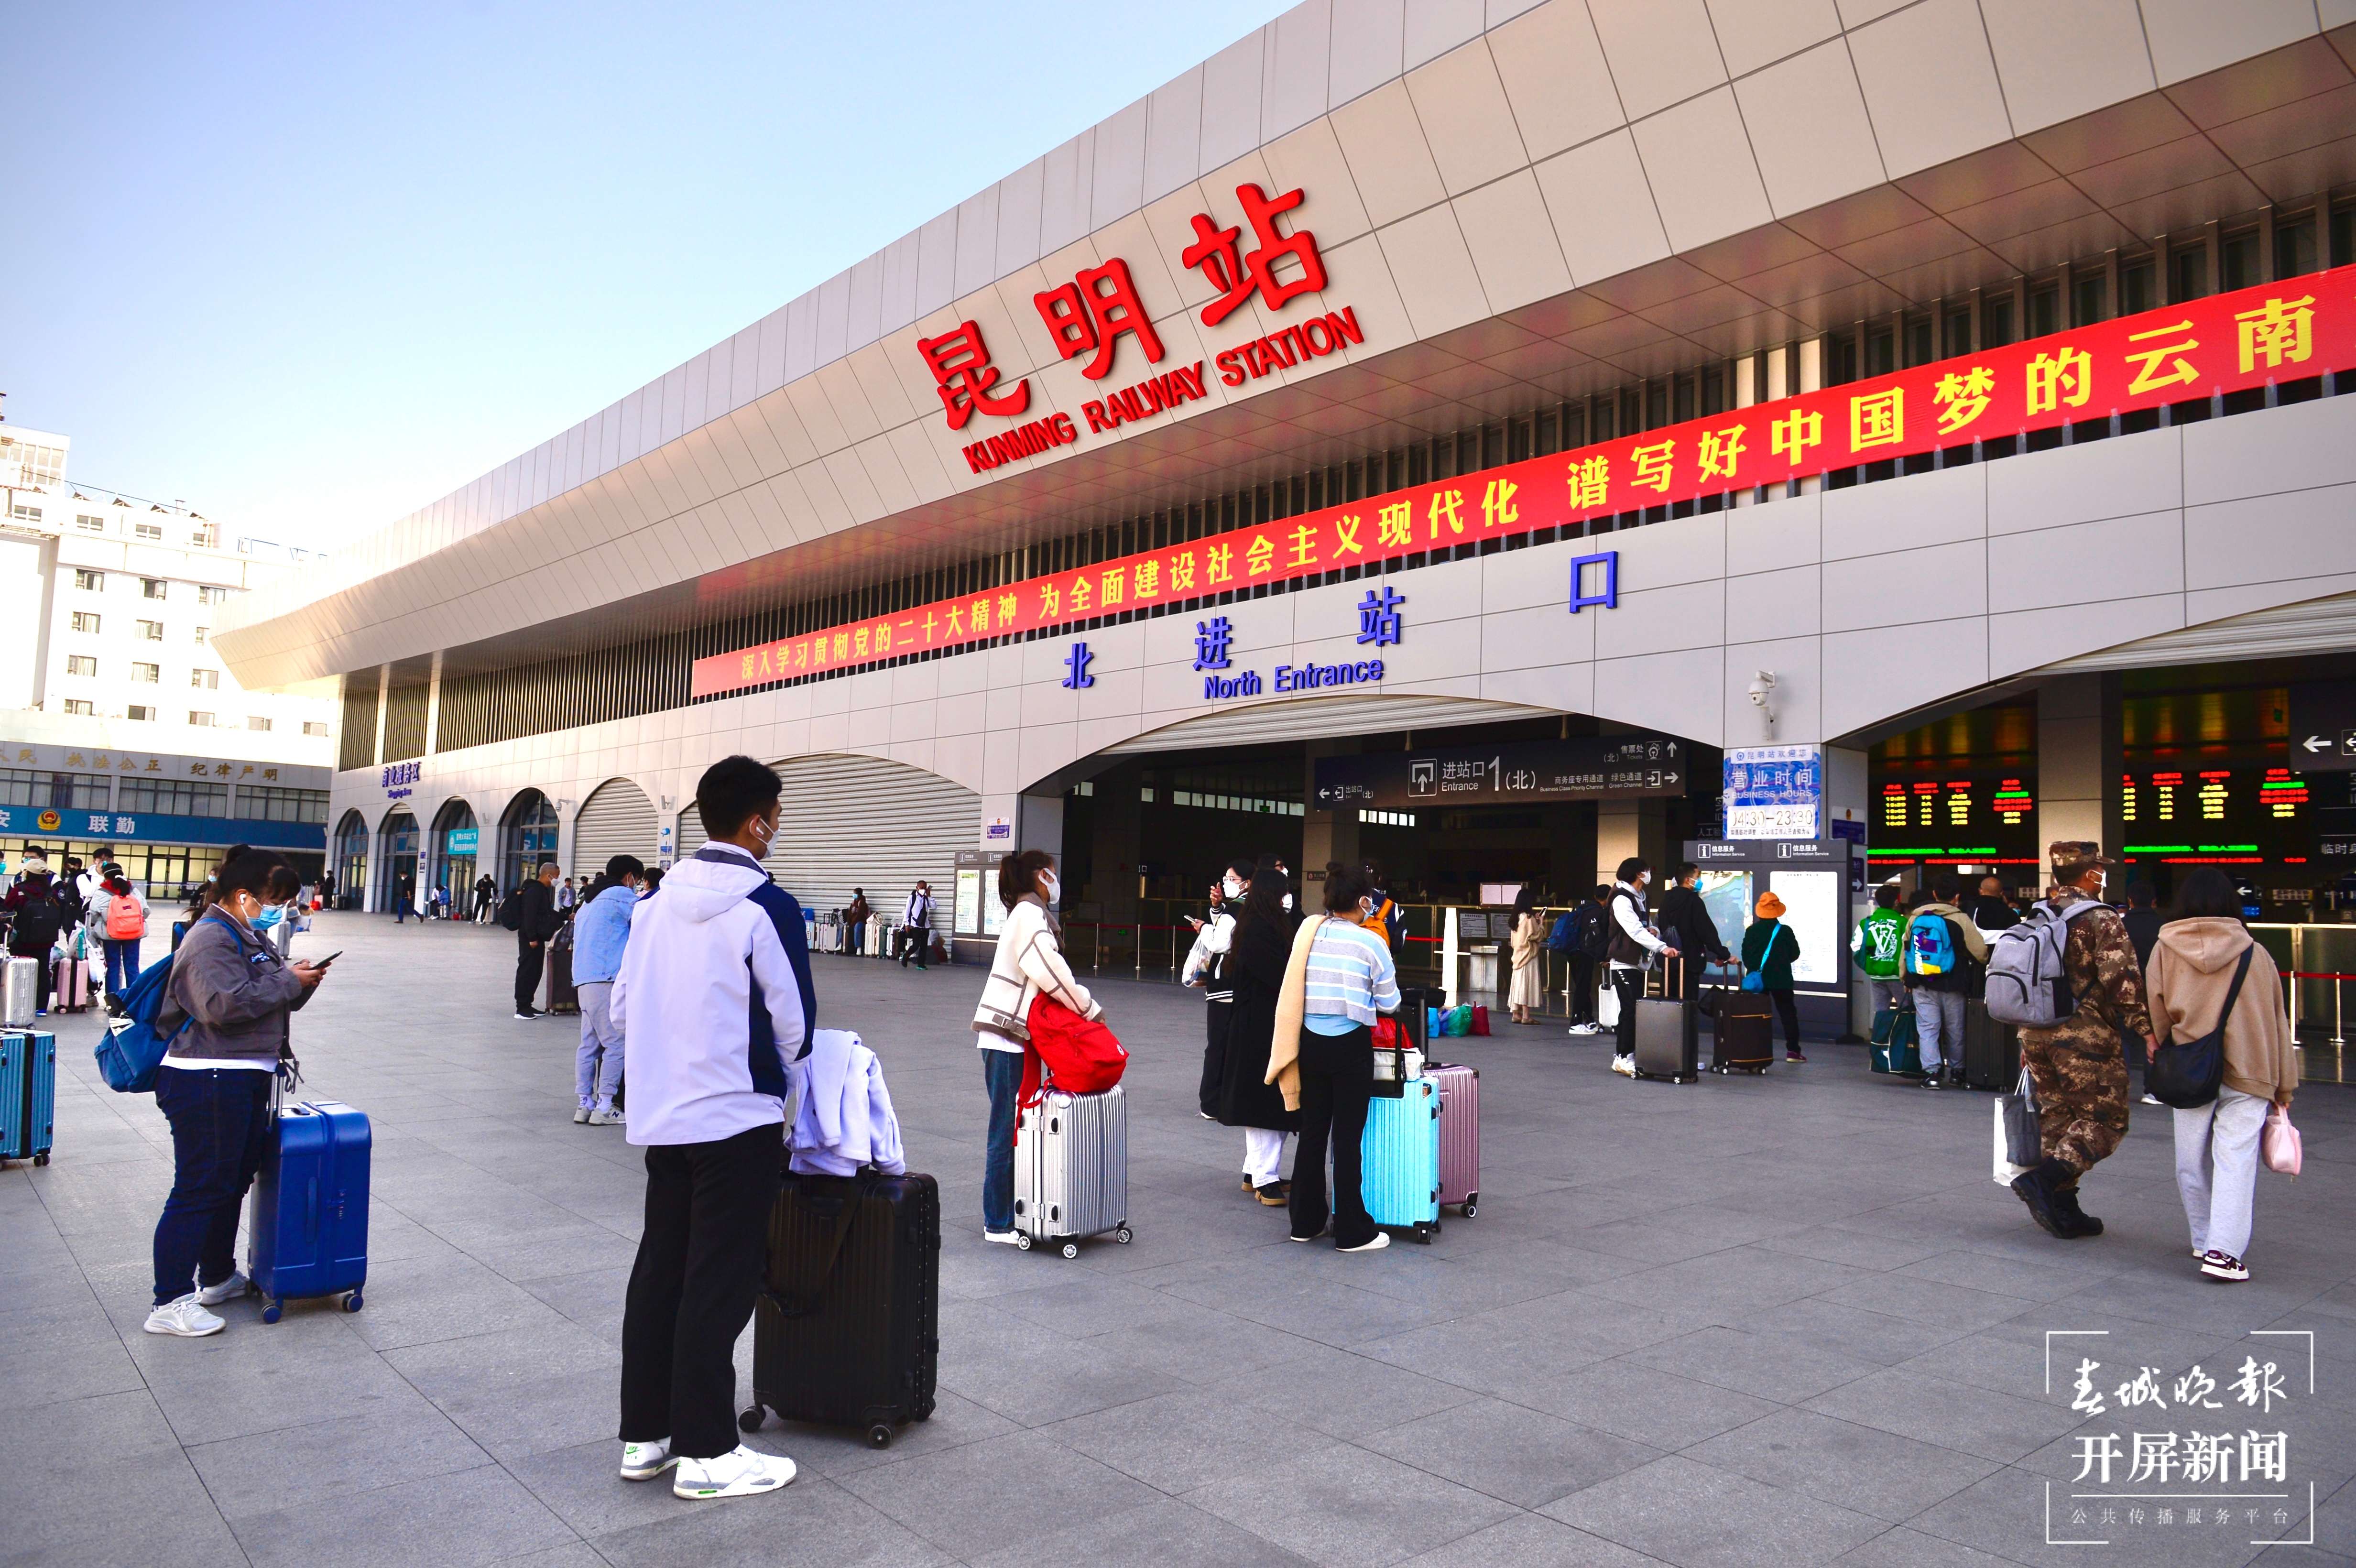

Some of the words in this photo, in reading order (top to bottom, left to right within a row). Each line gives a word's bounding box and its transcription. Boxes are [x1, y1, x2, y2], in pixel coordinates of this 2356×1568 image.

[916, 183, 1329, 431] 昆明站
[961, 412, 1079, 475] KUNMING
[1080, 360, 1208, 434] RAILWAY
[1215, 305, 1365, 387] STATION
[742, 592, 1018, 681] 深入学习贯彻党的二十大精神
[1038, 478, 1520, 621] 为全面建设社会主义现代化
[1567, 294, 2356, 510] 谱写好中国梦的云南
[1203, 670, 1261, 699] North
[1274, 659, 1384, 692] Entrance
[1621, 744, 1644, 754] 售票处
[1747, 749, 1807, 760] 昆明站欢迎您
[65, 752, 162, 772] 执法公正
[190, 762, 278, 781] 纪律严明
[382, 761, 422, 788] 商业服务区
[1442, 760, 1484, 779] 进站口
[1488, 756, 1500, 791] 1
[1555, 774, 1604, 785] 商务座专用通道
[1611, 772, 1643, 782] 绿色通道
[1732, 768, 1812, 789] 营业时间
[1441, 782, 1479, 792] Entrance
[1732, 790, 1776, 799] BUSINESS
[1780, 789, 1812, 797] HOURS
[88, 815, 135, 834] 联勤
